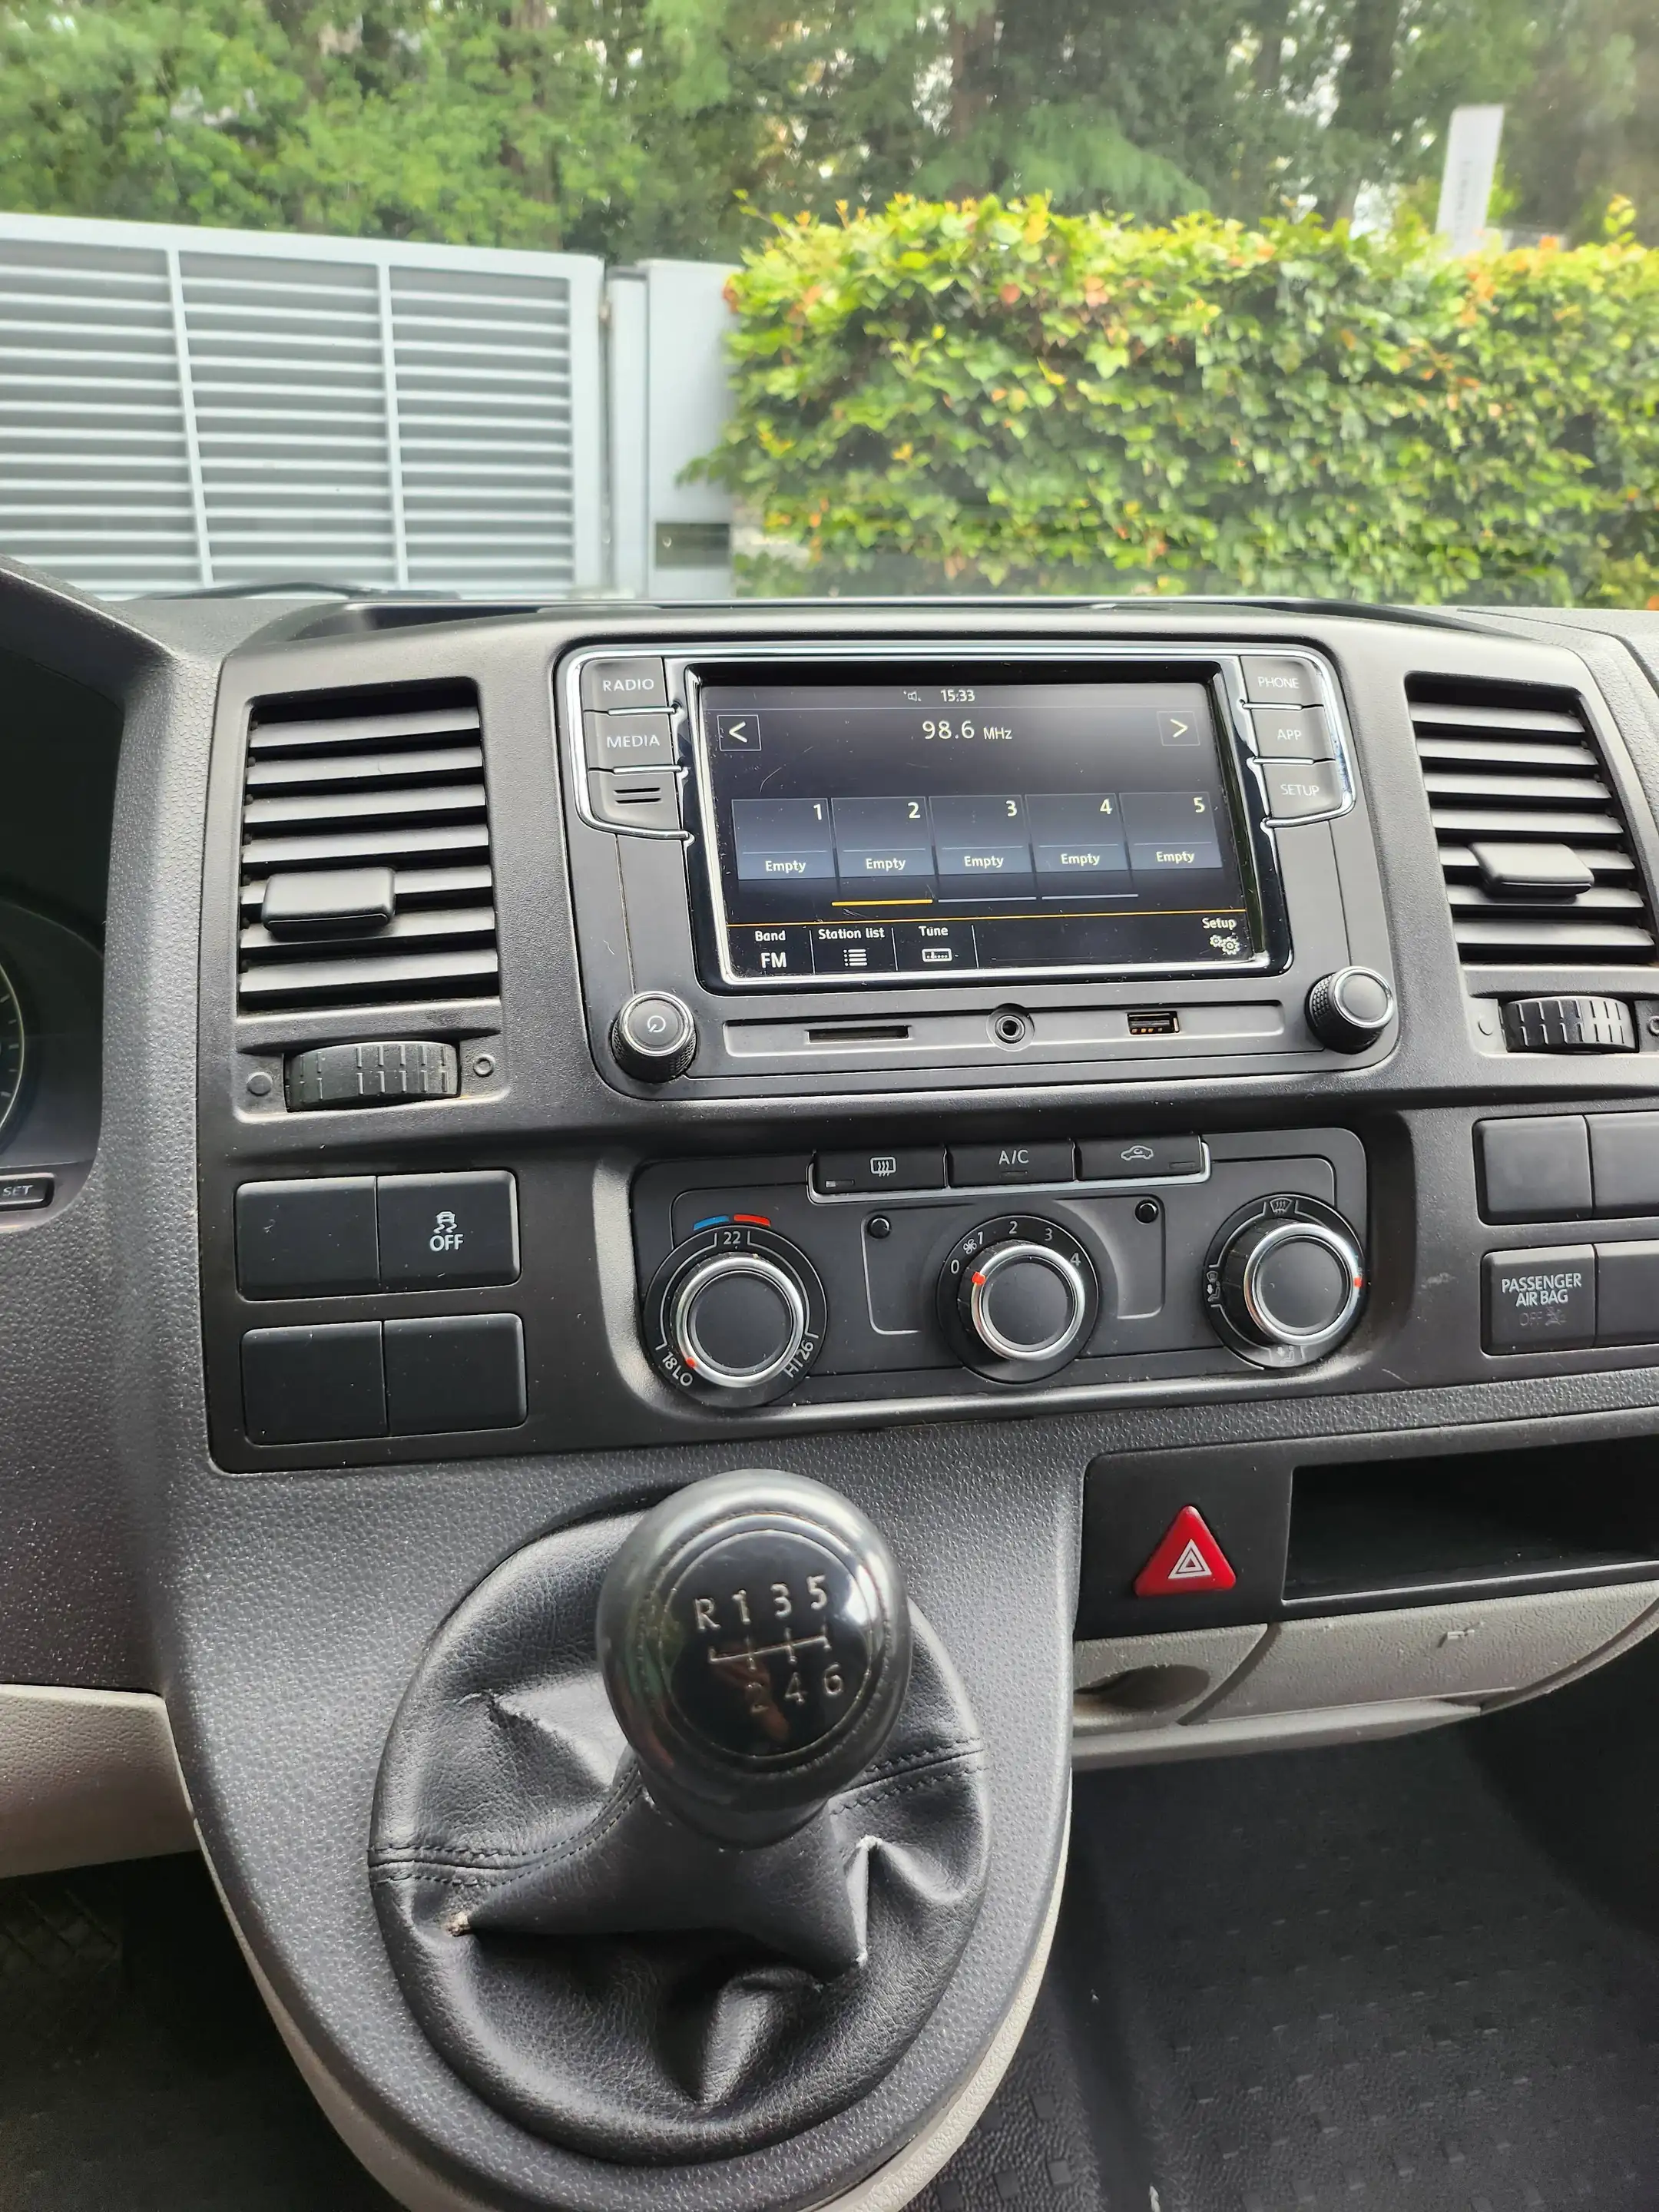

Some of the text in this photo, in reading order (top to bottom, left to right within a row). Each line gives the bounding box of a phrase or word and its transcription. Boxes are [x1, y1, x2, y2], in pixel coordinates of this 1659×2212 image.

[602, 677, 654, 691] RADIO
[1258, 677, 1300, 690] PHONE
[940, 689, 975, 702] 15:33
[922, 720, 1013, 740] 98.6 MHz
[1277, 729, 1302, 741] APP
[606, 733, 660, 749] MEDIA
[1281, 784, 1320, 797] SETUP
[813, 803, 823, 820] 1
[907, 802, 921, 819] 2
[1005, 800, 1018, 817] 3
[1100, 798, 1112, 815] 4
[1194, 797, 1205, 813] 5
[866, 856, 906, 872] Empty
[964, 854, 1004, 869] Empty
[1061, 853, 1101, 867] Empty
[1156, 850, 1195, 865] Empty
[765, 859, 806, 874] Empty
[919, 926, 949, 937] Tune
[1202, 917, 1237, 931] Setup
[754, 929, 786, 942] Band
[818, 926, 885, 940] Station list
[761, 952, 786, 969] FM
[998, 1149, 1029, 1165] A/C
[2, 1184, 34, 1197] SET
[1008, 1220, 1018, 1235] 2
[1044, 1227, 1053, 1242] 3
[429, 1233, 464, 1252] OFF
[723, 1231, 741, 1245] 22
[977, 1231, 985, 1245] 1
[950, 1259, 960, 1275] 0
[1070, 1252, 1081, 1267] 4
[1501, 1273, 1582, 1293] PASSENGER
[1515, 1289, 1568, 1307] AIR BAG
[783, 1339, 814, 1379] HI 26
[662, 1352, 694, 1386] 18 LO
[694, 1575, 826, 1630] R 1 3 5
[784, 1671, 807, 1705] 4
[824, 1663, 844, 1697] 6
